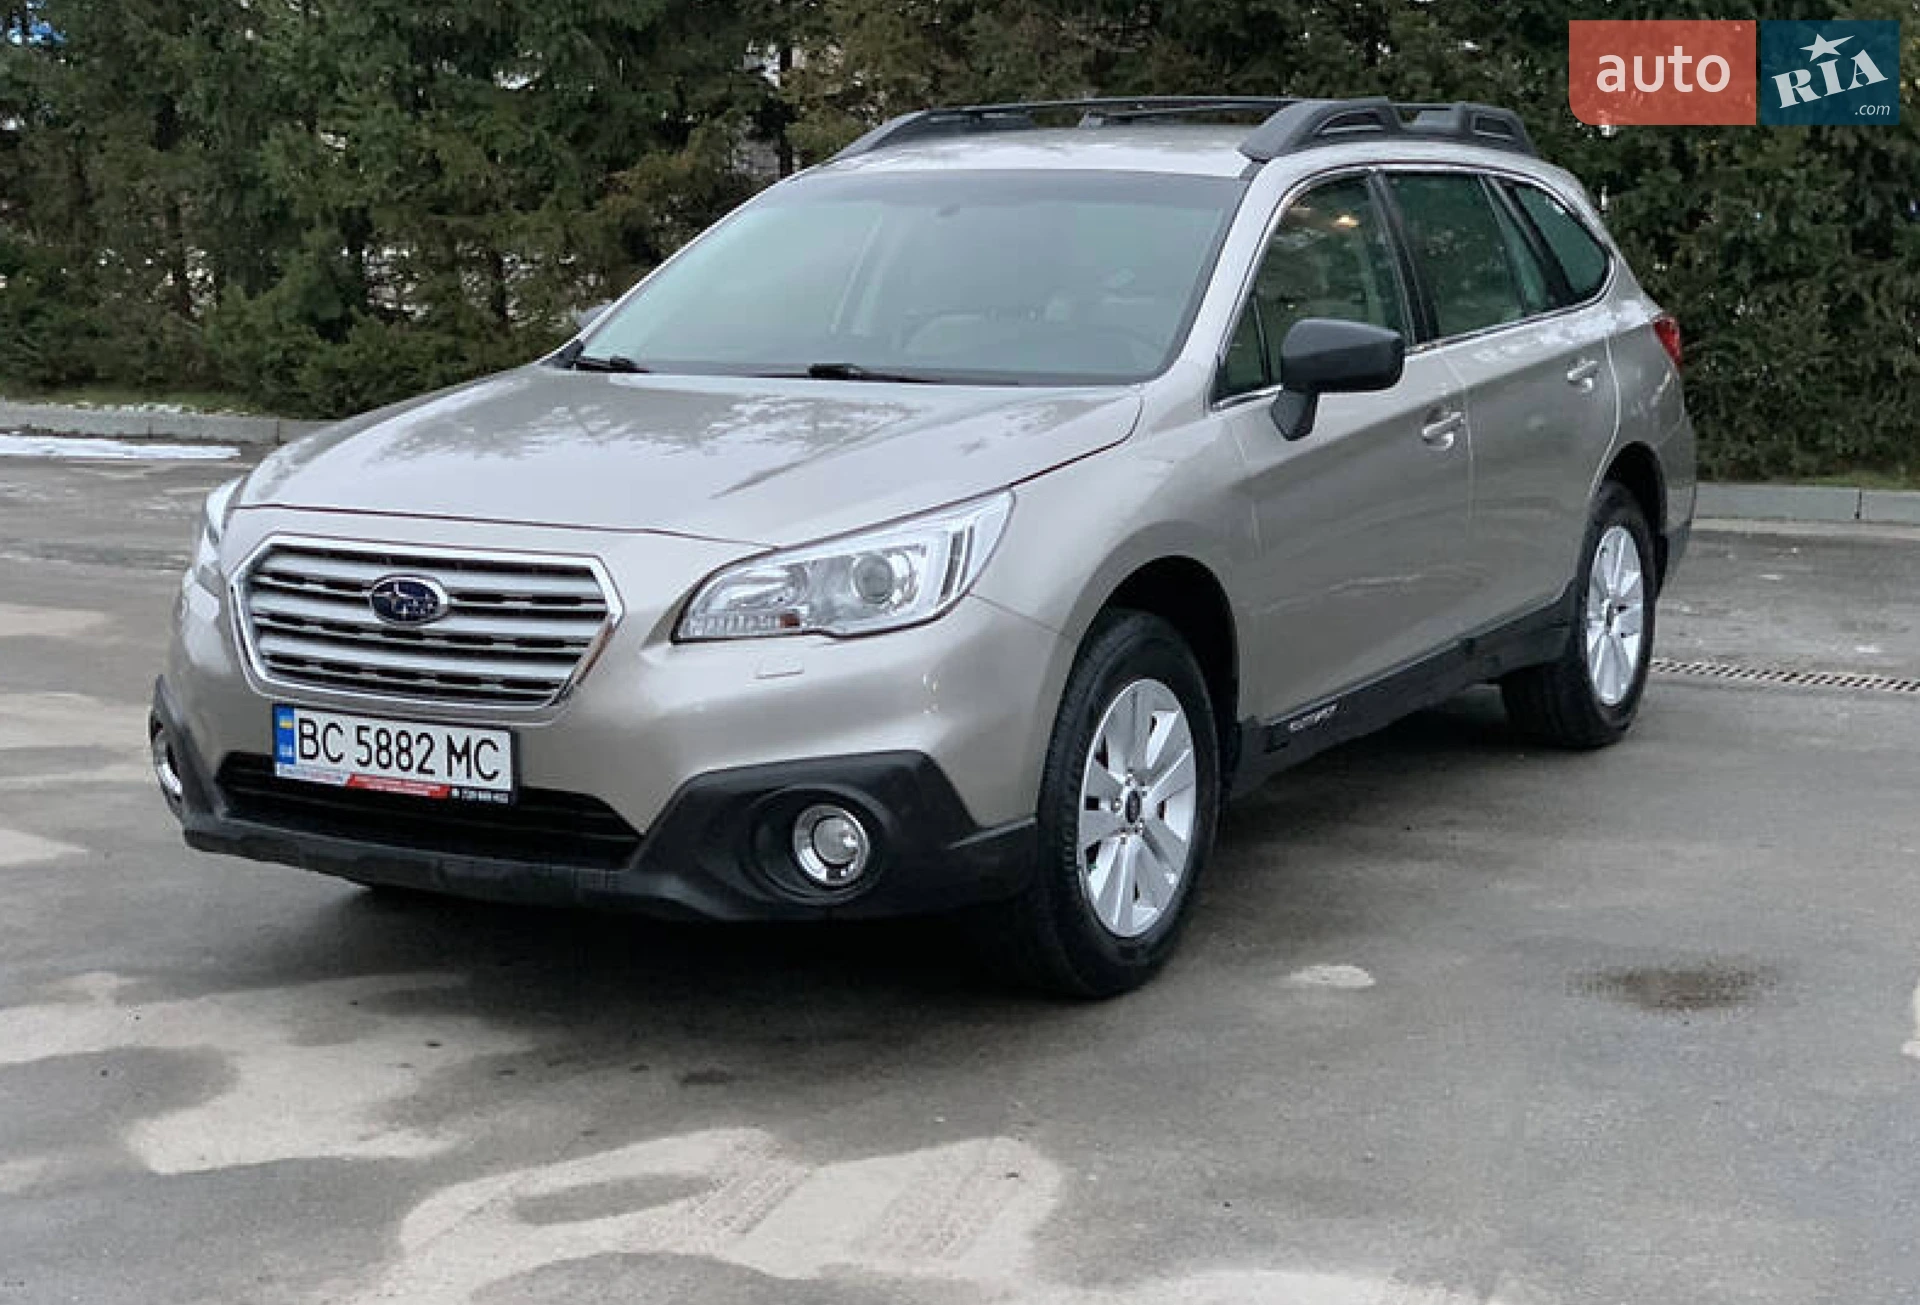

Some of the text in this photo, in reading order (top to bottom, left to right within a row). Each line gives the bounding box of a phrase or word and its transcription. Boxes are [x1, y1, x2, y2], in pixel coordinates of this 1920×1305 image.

[298, 717, 500, 782] BC 5882 MC
